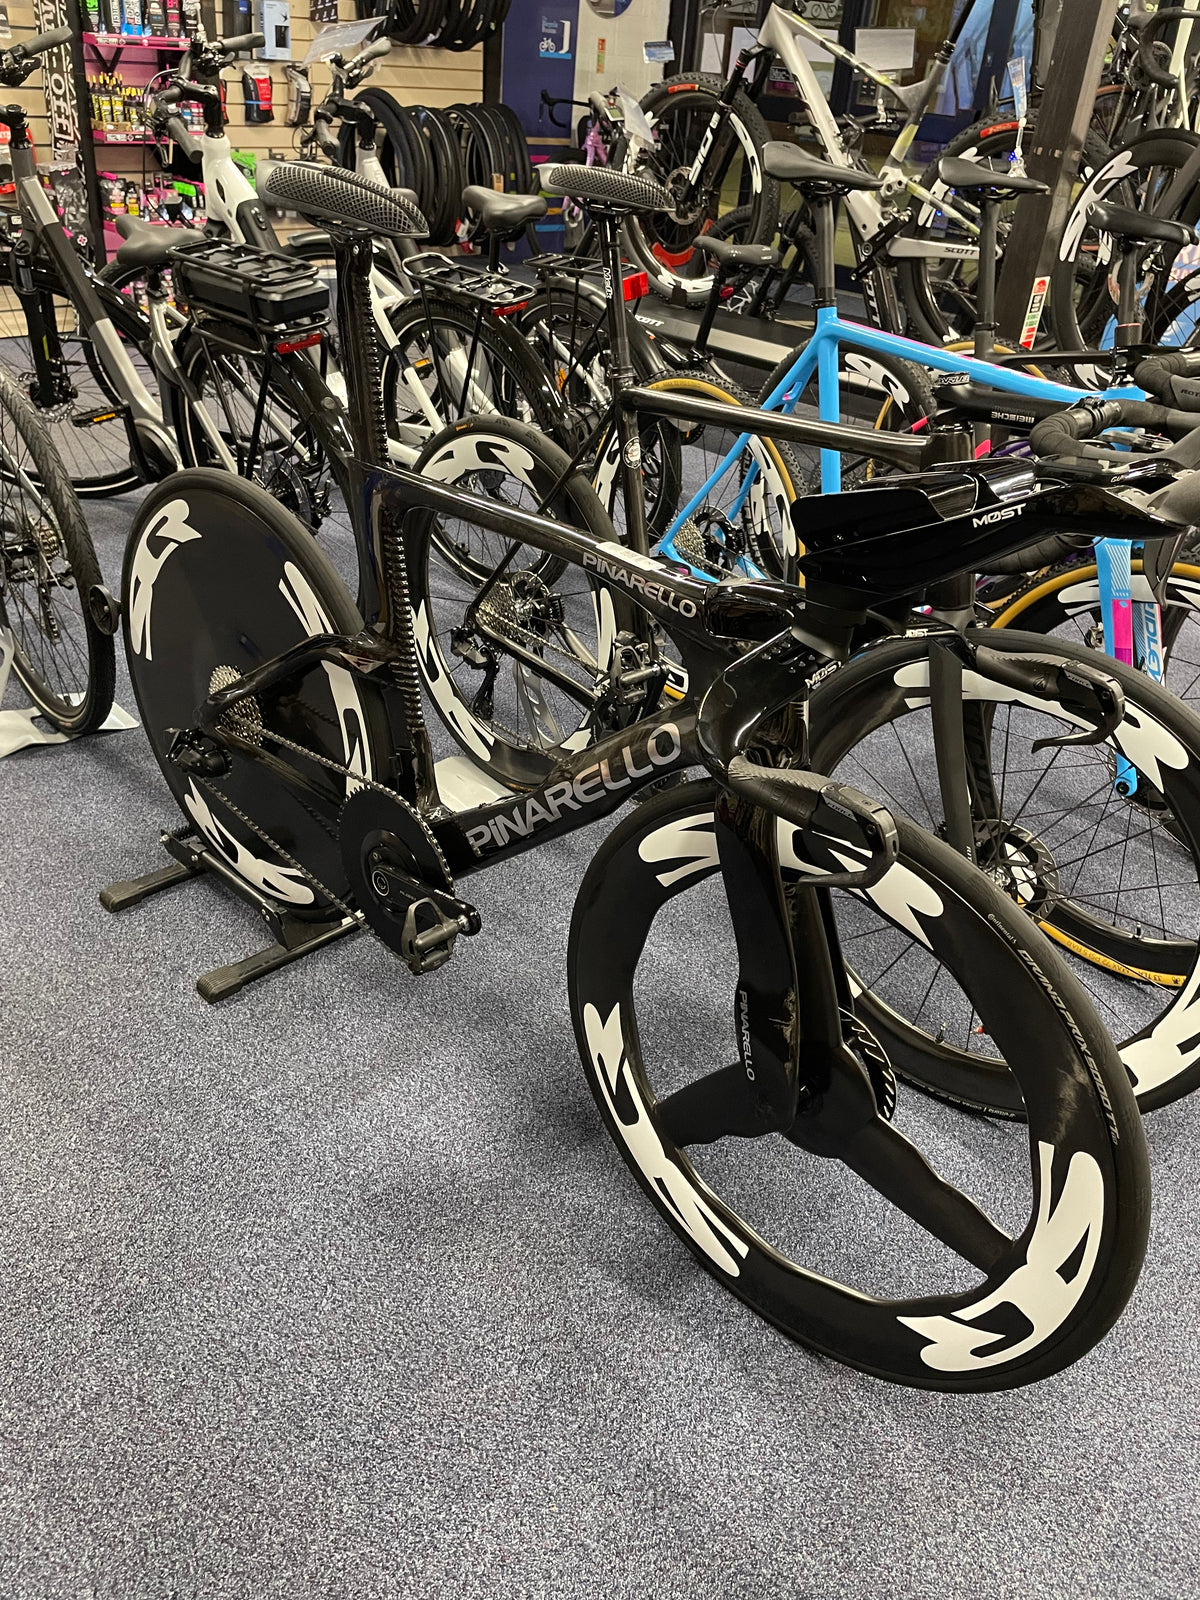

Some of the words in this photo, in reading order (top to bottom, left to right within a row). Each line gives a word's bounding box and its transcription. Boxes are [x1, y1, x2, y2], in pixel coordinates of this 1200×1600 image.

[944, 246, 976, 256] SCOTT
[1180, 388, 1200, 398] ROT
[582, 552, 697, 618] PINARELLO
[466, 722, 682, 851] PINARELLO
[739, 990, 756, 1081] PINARELLO
[1018, 950, 1066, 1007] GRAND
[1059, 1010, 1092, 1055] PRIX
[1084, 1055, 1113, 1111] 5000
